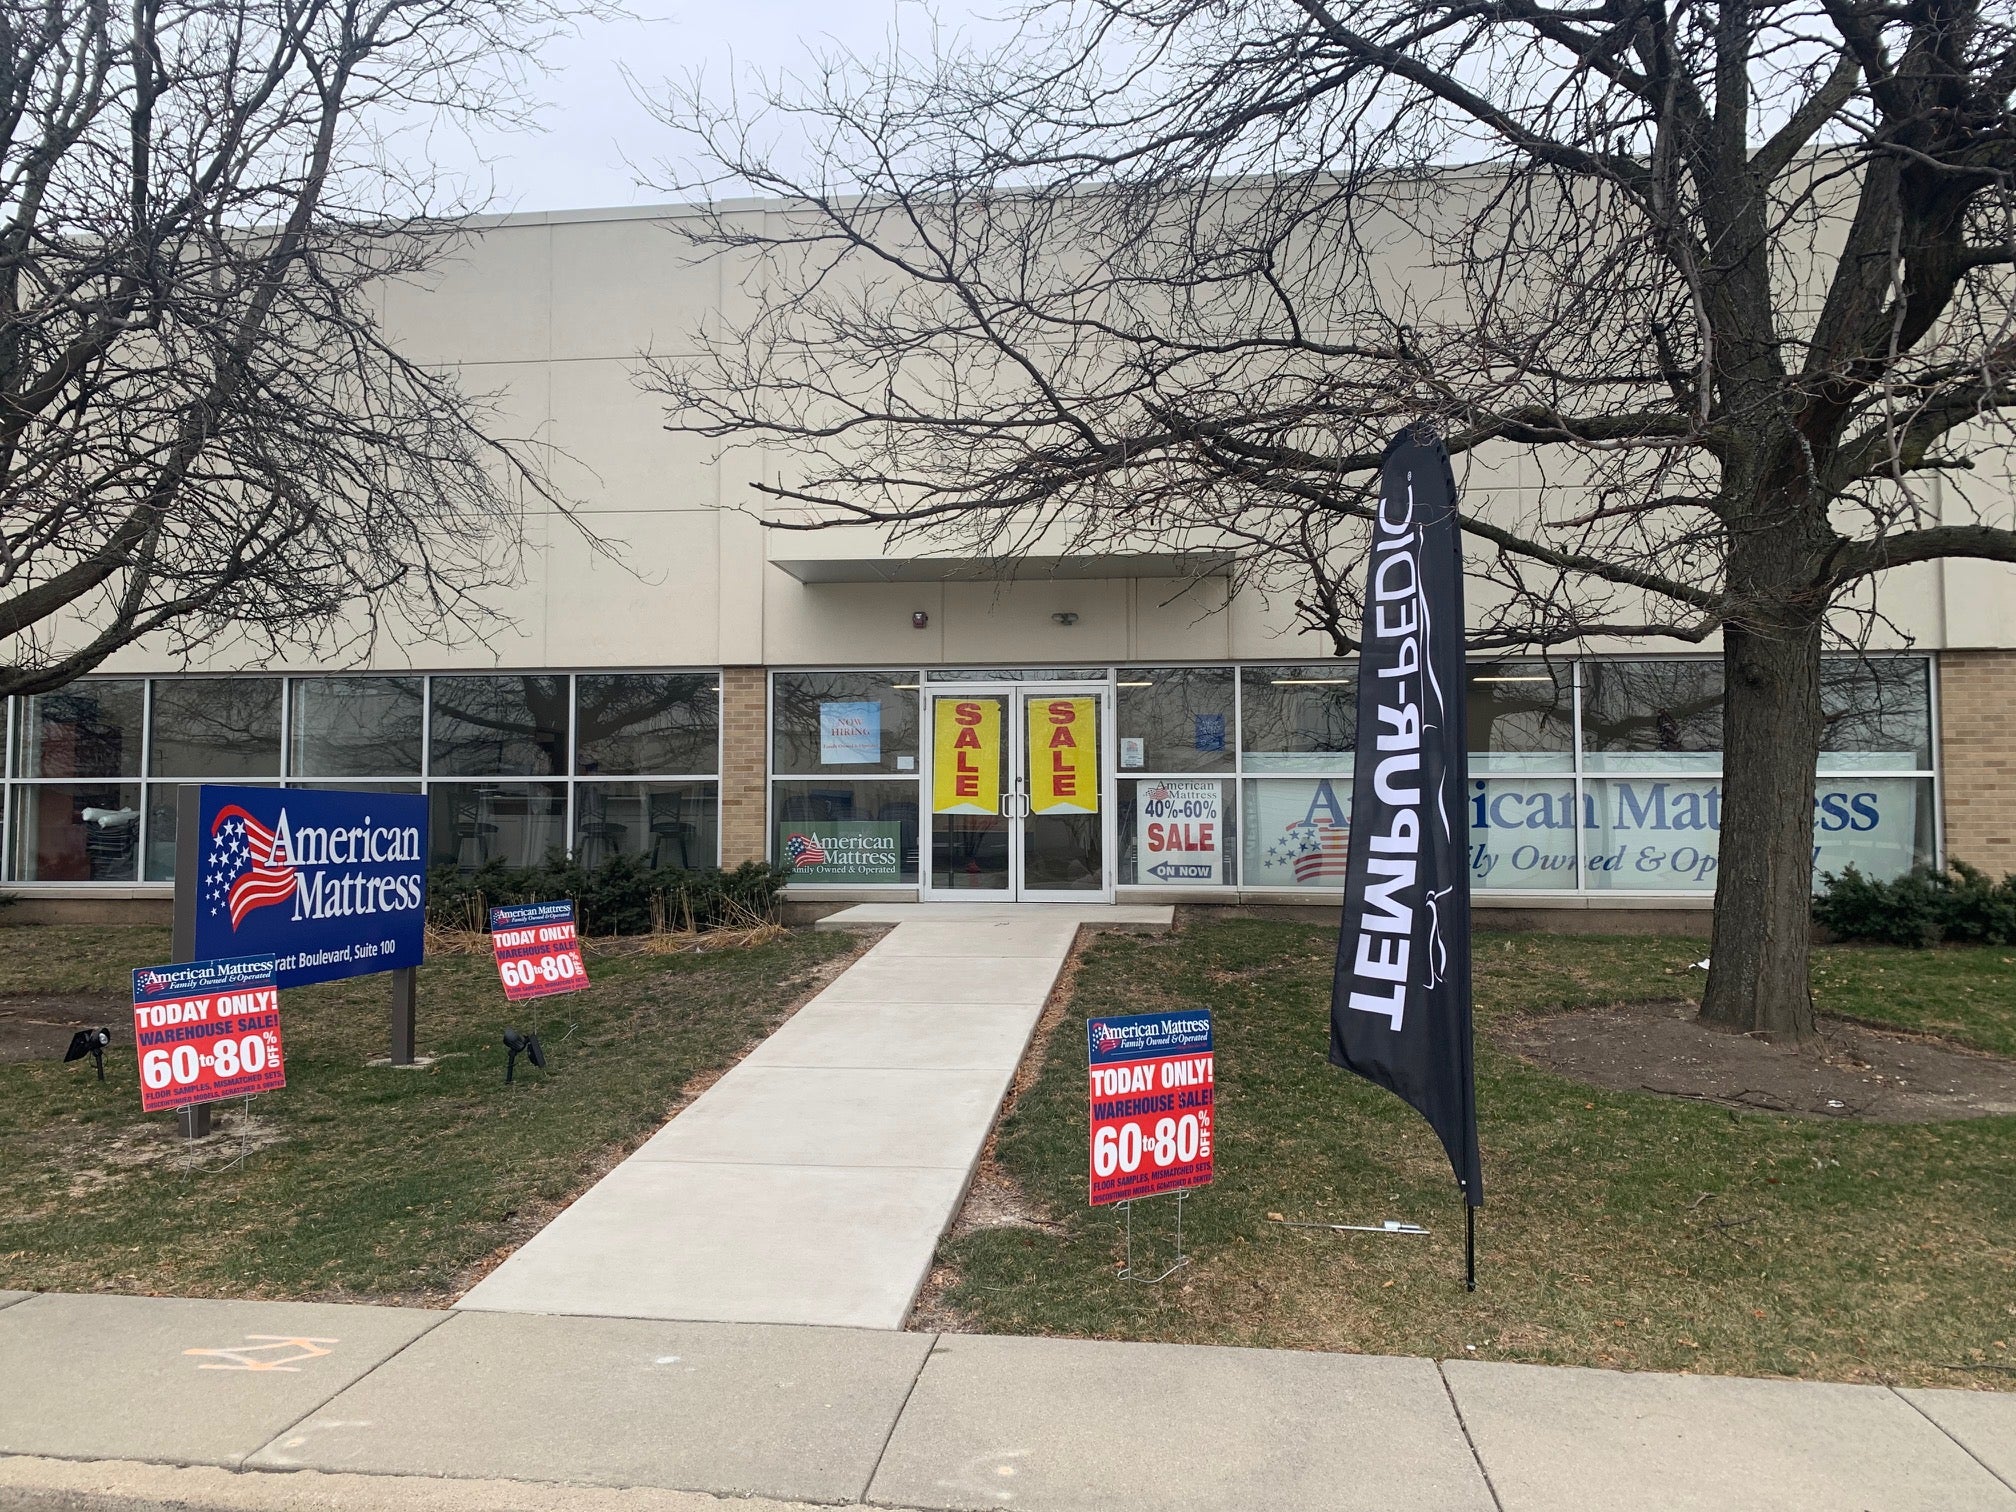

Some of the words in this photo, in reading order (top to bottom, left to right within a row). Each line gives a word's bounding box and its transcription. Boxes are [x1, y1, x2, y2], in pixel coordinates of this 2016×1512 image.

[831, 728, 870, 736] HIRING
[837, 718, 863, 726] NOW
[954, 703, 982, 797] SALE
[1048, 701, 1077, 796] SALE
[1157, 780, 1214, 791] American
[1168, 791, 1217, 799] Mattress
[1145, 800, 1217, 818] 40%-60%
[1298, 779, 1599, 829] Aican
[1613, 783, 1879, 831] Matss
[264, 807, 421, 866] American
[807, 832, 894, 850] American
[1147, 823, 1215, 852] SALE
[823, 850, 896, 865] Mattress
[792, 866, 814, 875] amily
[817, 866, 846, 874] Owned
[858, 866, 896, 875] Operated
[1157, 866, 1175, 876] ON
[1180, 866, 1210, 876] NOW
[291, 870, 422, 921] Mattress
[498, 908, 538, 919] American
[538, 904, 571, 914] Mattress
[493, 930, 536, 948] TODAY
[540, 925, 576, 942] ONLY!
[275, 955, 296, 972] ratt
[299, 946, 353, 967] Boulevard,
[354, 942, 378, 959] Suite
[380, 940, 396, 954] 100
[497, 945, 551, 960] WAREHOUSE
[553, 940, 578, 951] SALE!
[146, 967, 215, 985] American
[217, 961, 273, 976] Mattress
[501, 959, 535, 987] 60
[534, 965, 543, 974] to
[541, 954, 575, 981] 80
[574, 960, 584, 975] OFF
[170, 979, 198, 990] Family
[200, 976, 227, 986] Owned
[136, 1000, 210, 1029] TODAY
[217, 990, 277, 1018] ONLY!
[139, 1020, 234, 1046] WAREHOUSE
[238, 1014, 278, 1032] SALE!
[1100, 1021, 1160, 1040] American
[1161, 1018, 1210, 1036] Mattress
[1120, 1038, 1145, 1050] Family
[1146, 1036, 1170, 1047] Owned
[143, 1045, 199, 1089] 60
[199, 1053, 214, 1067] to
[213, 1035, 265, 1078] 80
[267, 1046, 281, 1068] OFF
[1091, 1064, 1156, 1097] TODAY
[1161, 1058, 1213, 1089] ONLY!
[146, 1089, 171, 1100] FLOOR
[1094, 1094, 1175, 1121] WAREHOUSE
[1178, 1088, 1213, 1109] SALE!
[1093, 1122, 1142, 1177] 60
[1143, 1135, 1155, 1152] to
[1154, 1114, 1199, 1167] 80
[1200, 1129, 1211, 1158] OFF
[1093, 1179, 1115, 1192] FLOOR
[1117, 1173, 1150, 1187] SAMPLES,
[1151, 1165, 1194, 1180] MISMATCHED
